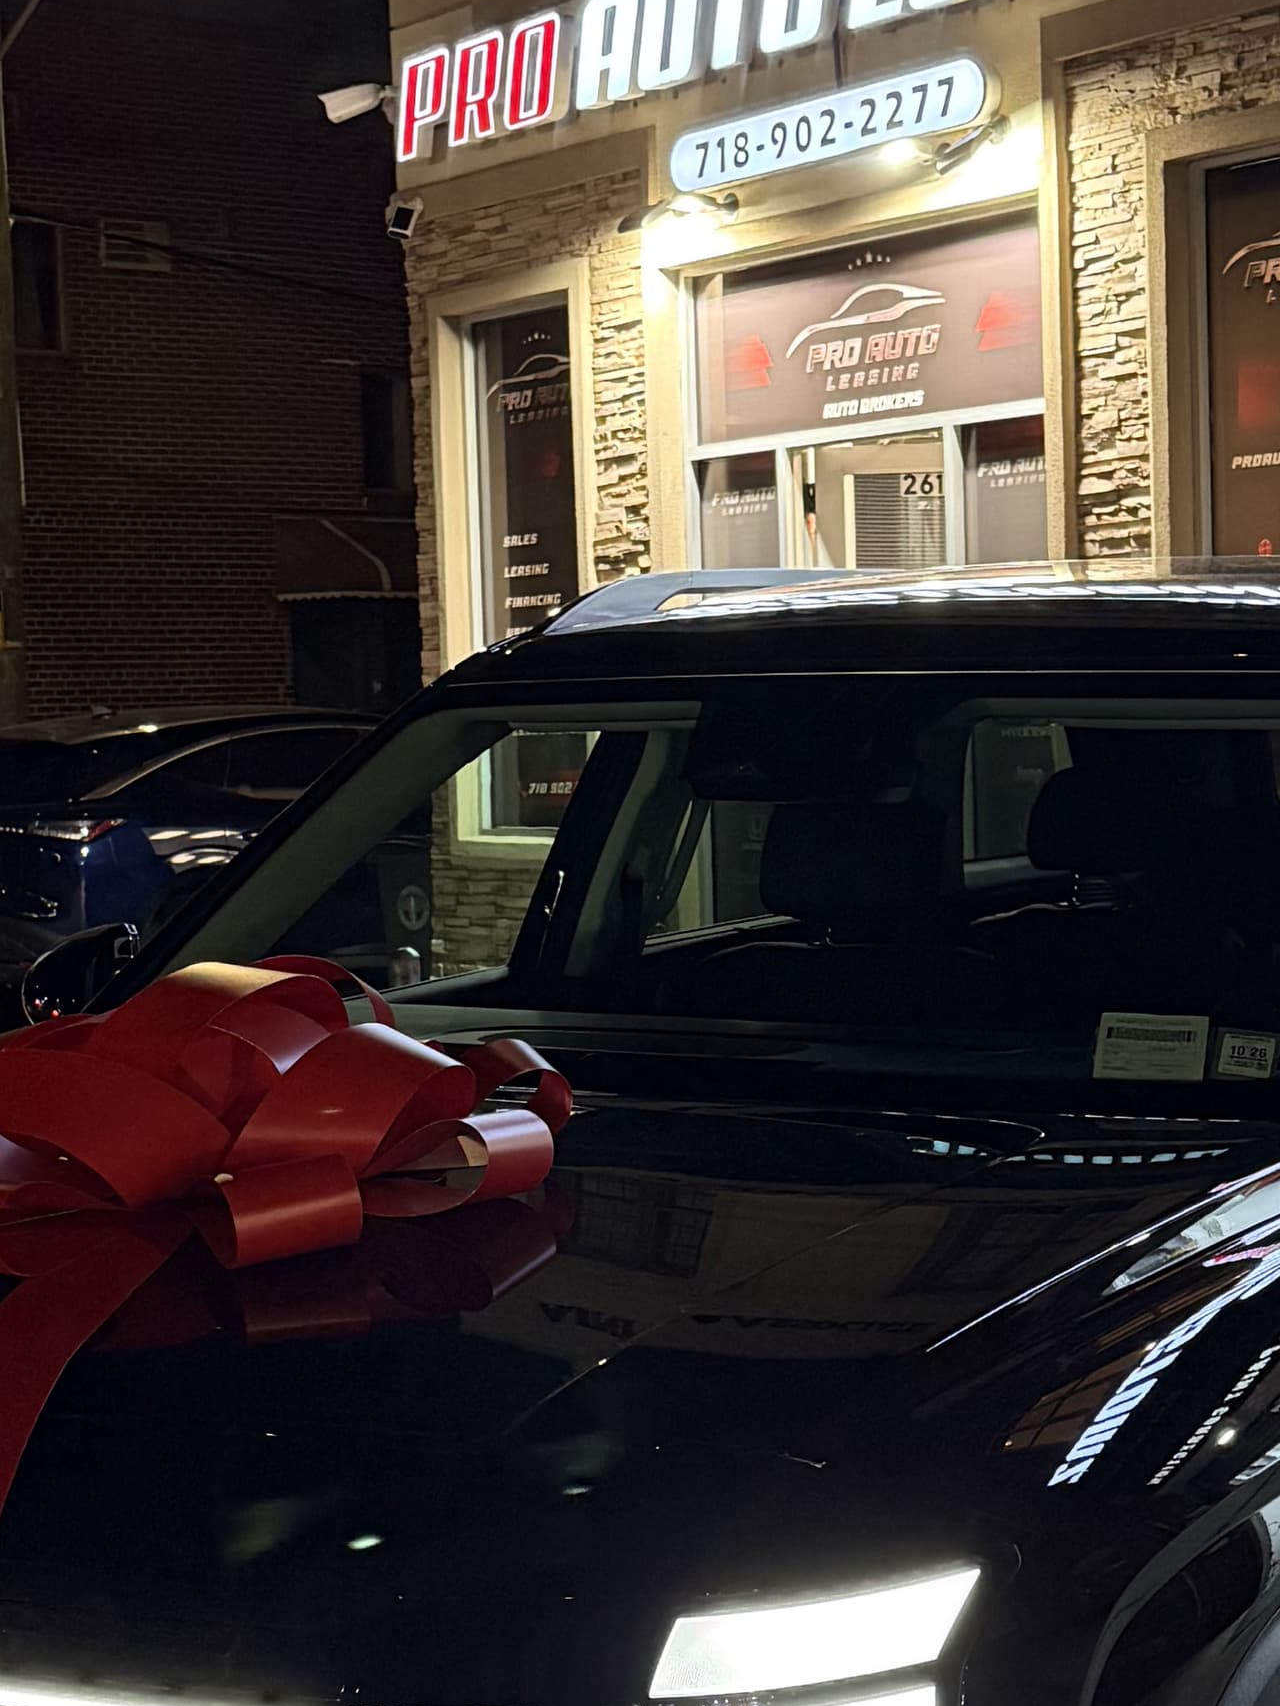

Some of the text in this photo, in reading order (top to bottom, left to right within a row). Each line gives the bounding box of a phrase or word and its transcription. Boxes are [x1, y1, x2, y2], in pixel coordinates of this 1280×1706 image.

[397, 11, 561, 163] PRO
[693, 78, 956, 176] 718-902-2277
[806, 323, 941, 374] PRO AUTO
[825, 361, 920, 392] LEASING
[822, 399, 860, 420] AUTO
[502, 533, 539, 548] SALES
[503, 562, 550, 579] LEASING
[504, 593, 562, 610] FINANCING
